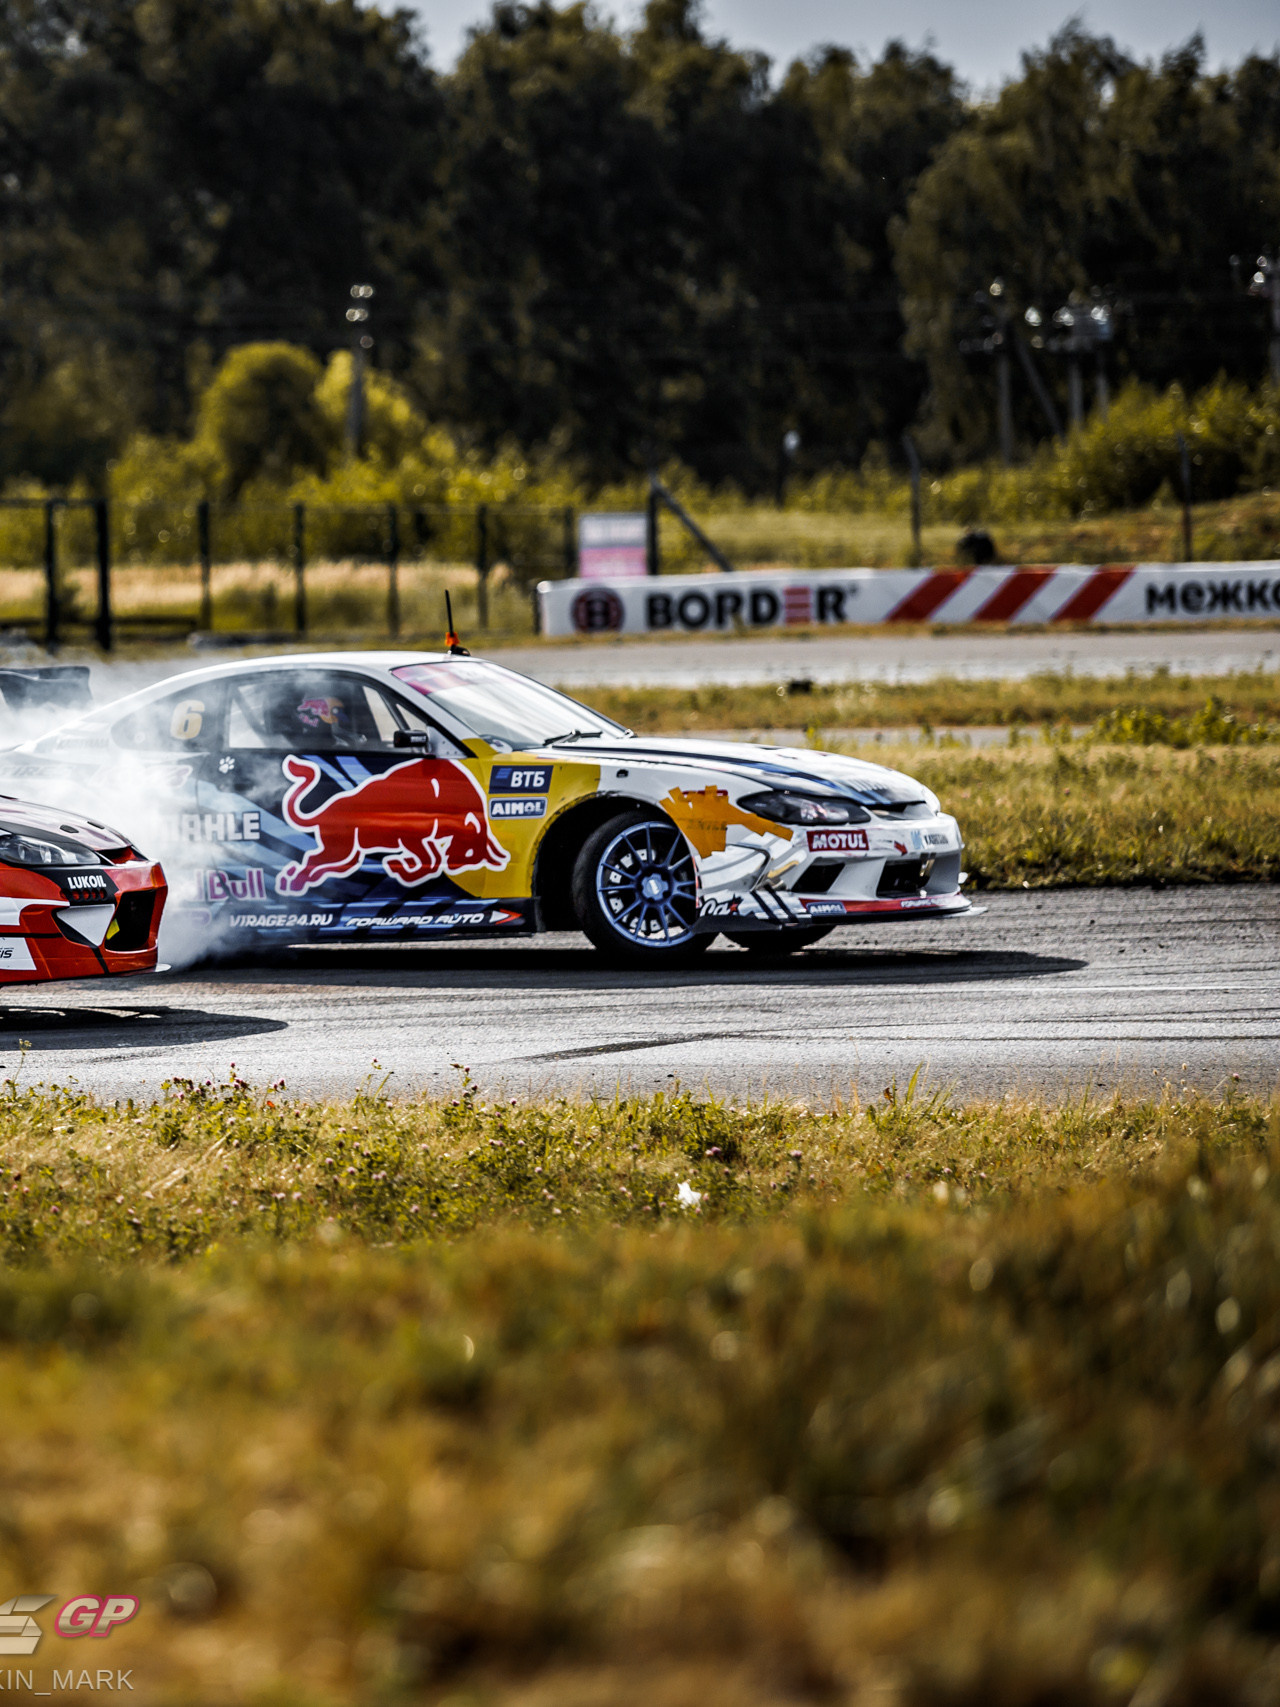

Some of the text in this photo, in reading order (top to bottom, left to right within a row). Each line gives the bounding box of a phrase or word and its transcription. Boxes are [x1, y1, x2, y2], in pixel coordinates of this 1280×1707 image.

[646, 585, 847, 630] BORDER
[171, 699, 205, 740] 6
[510, 770, 546, 788] ВТБ
[491, 801, 543, 815] AIMOL
[812, 833, 867, 849] MOTUL
[67, 874, 107, 890] LUKOIL
[208, 868, 267, 901] Bull
[229, 914, 334, 928] VIRAGE24.RU
[345, 913, 485, 927] FORWARD AUTO
